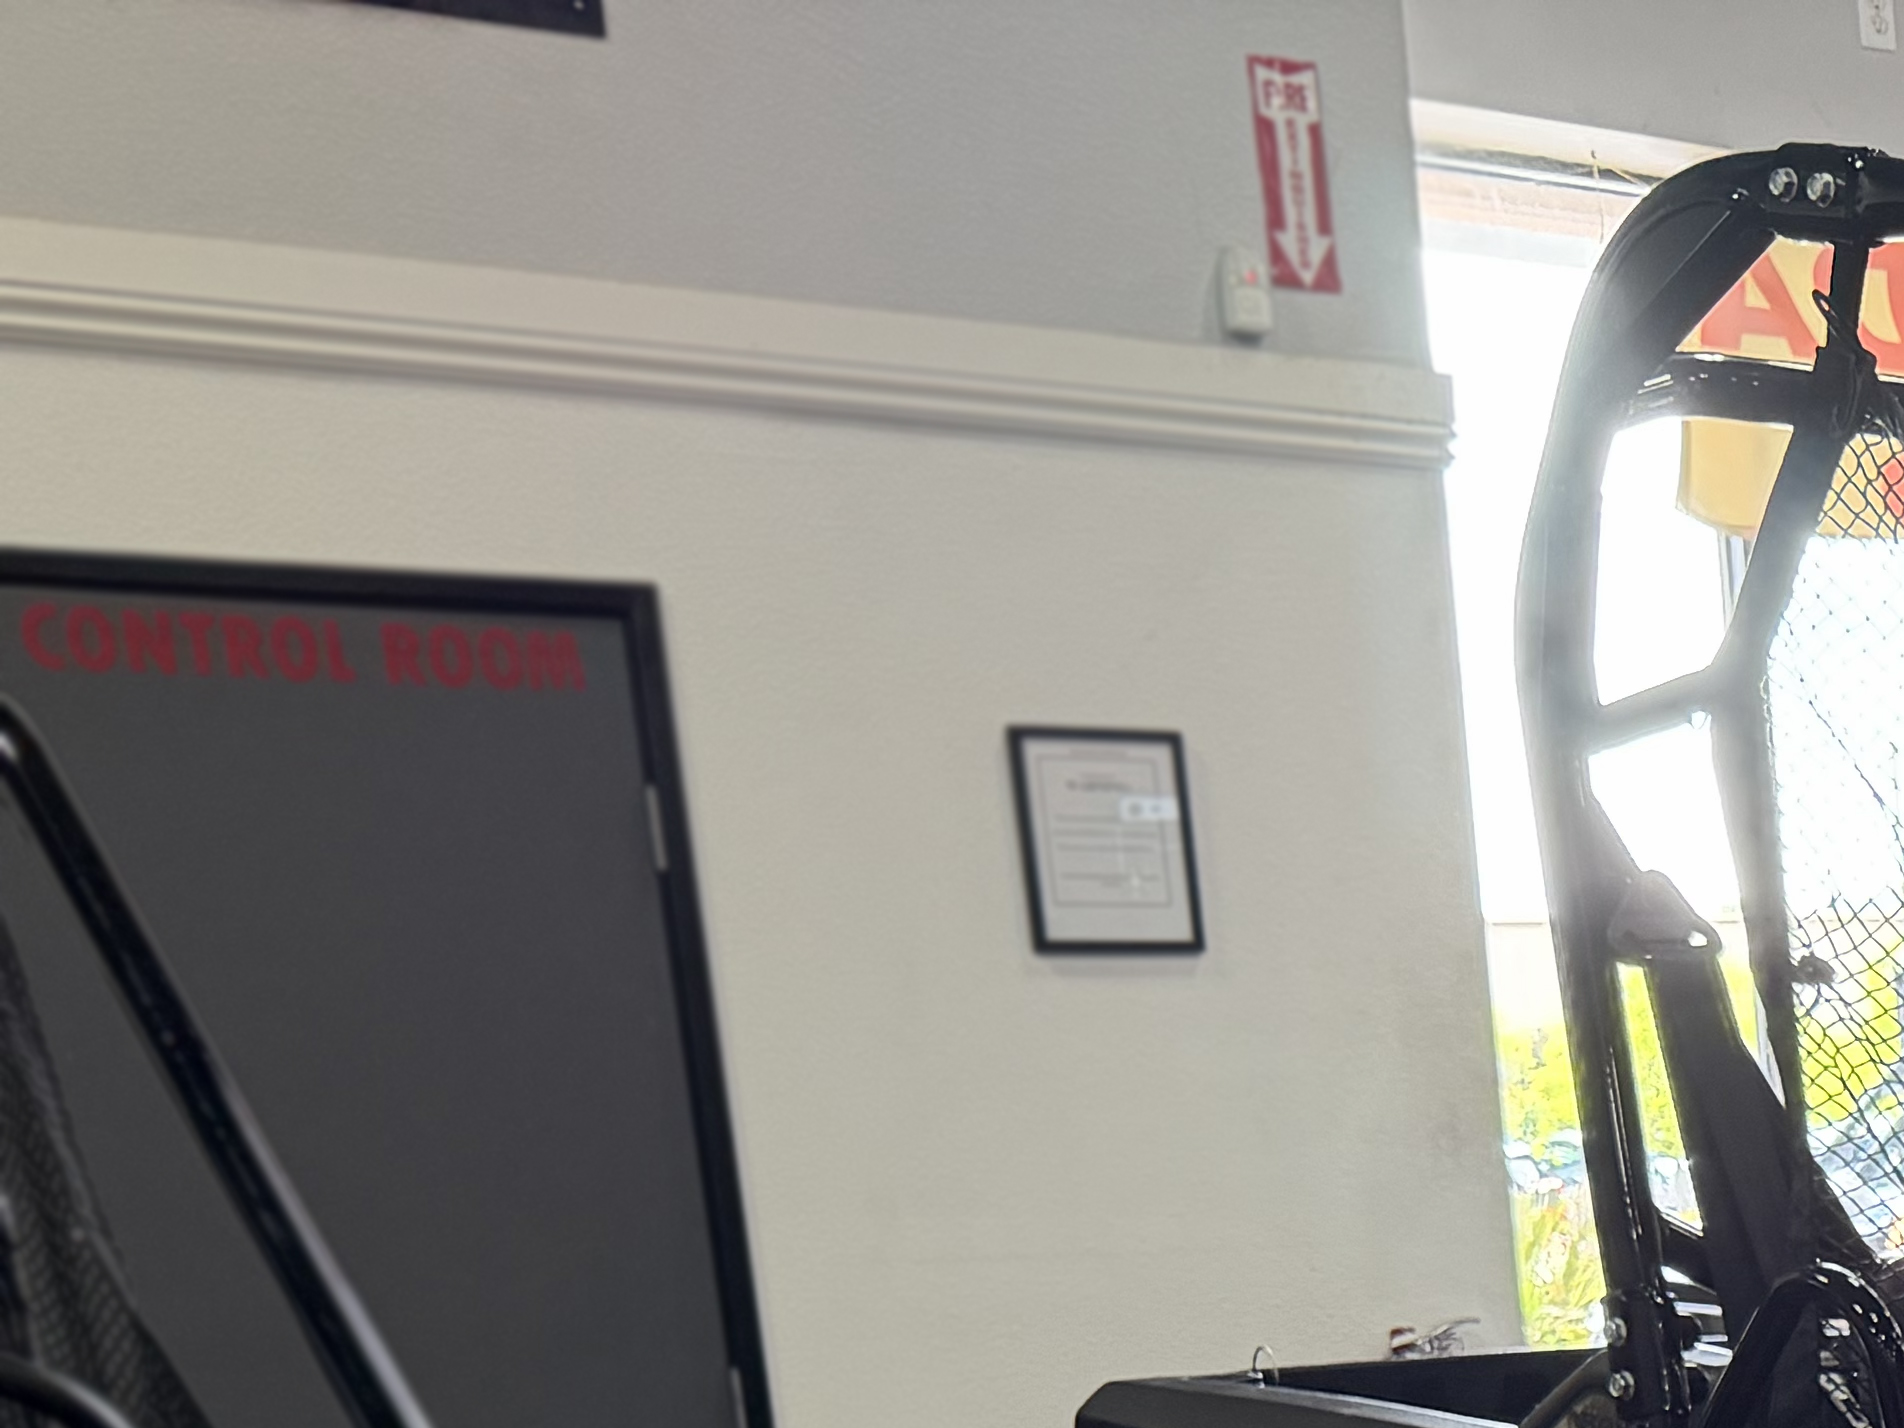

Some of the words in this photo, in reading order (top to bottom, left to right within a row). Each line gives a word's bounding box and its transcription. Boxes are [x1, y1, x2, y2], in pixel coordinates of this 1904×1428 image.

[1261, 78, 1310, 114] FRE
[20, 602, 357, 684] CONTROL
[379, 621, 587, 692] ROOM
